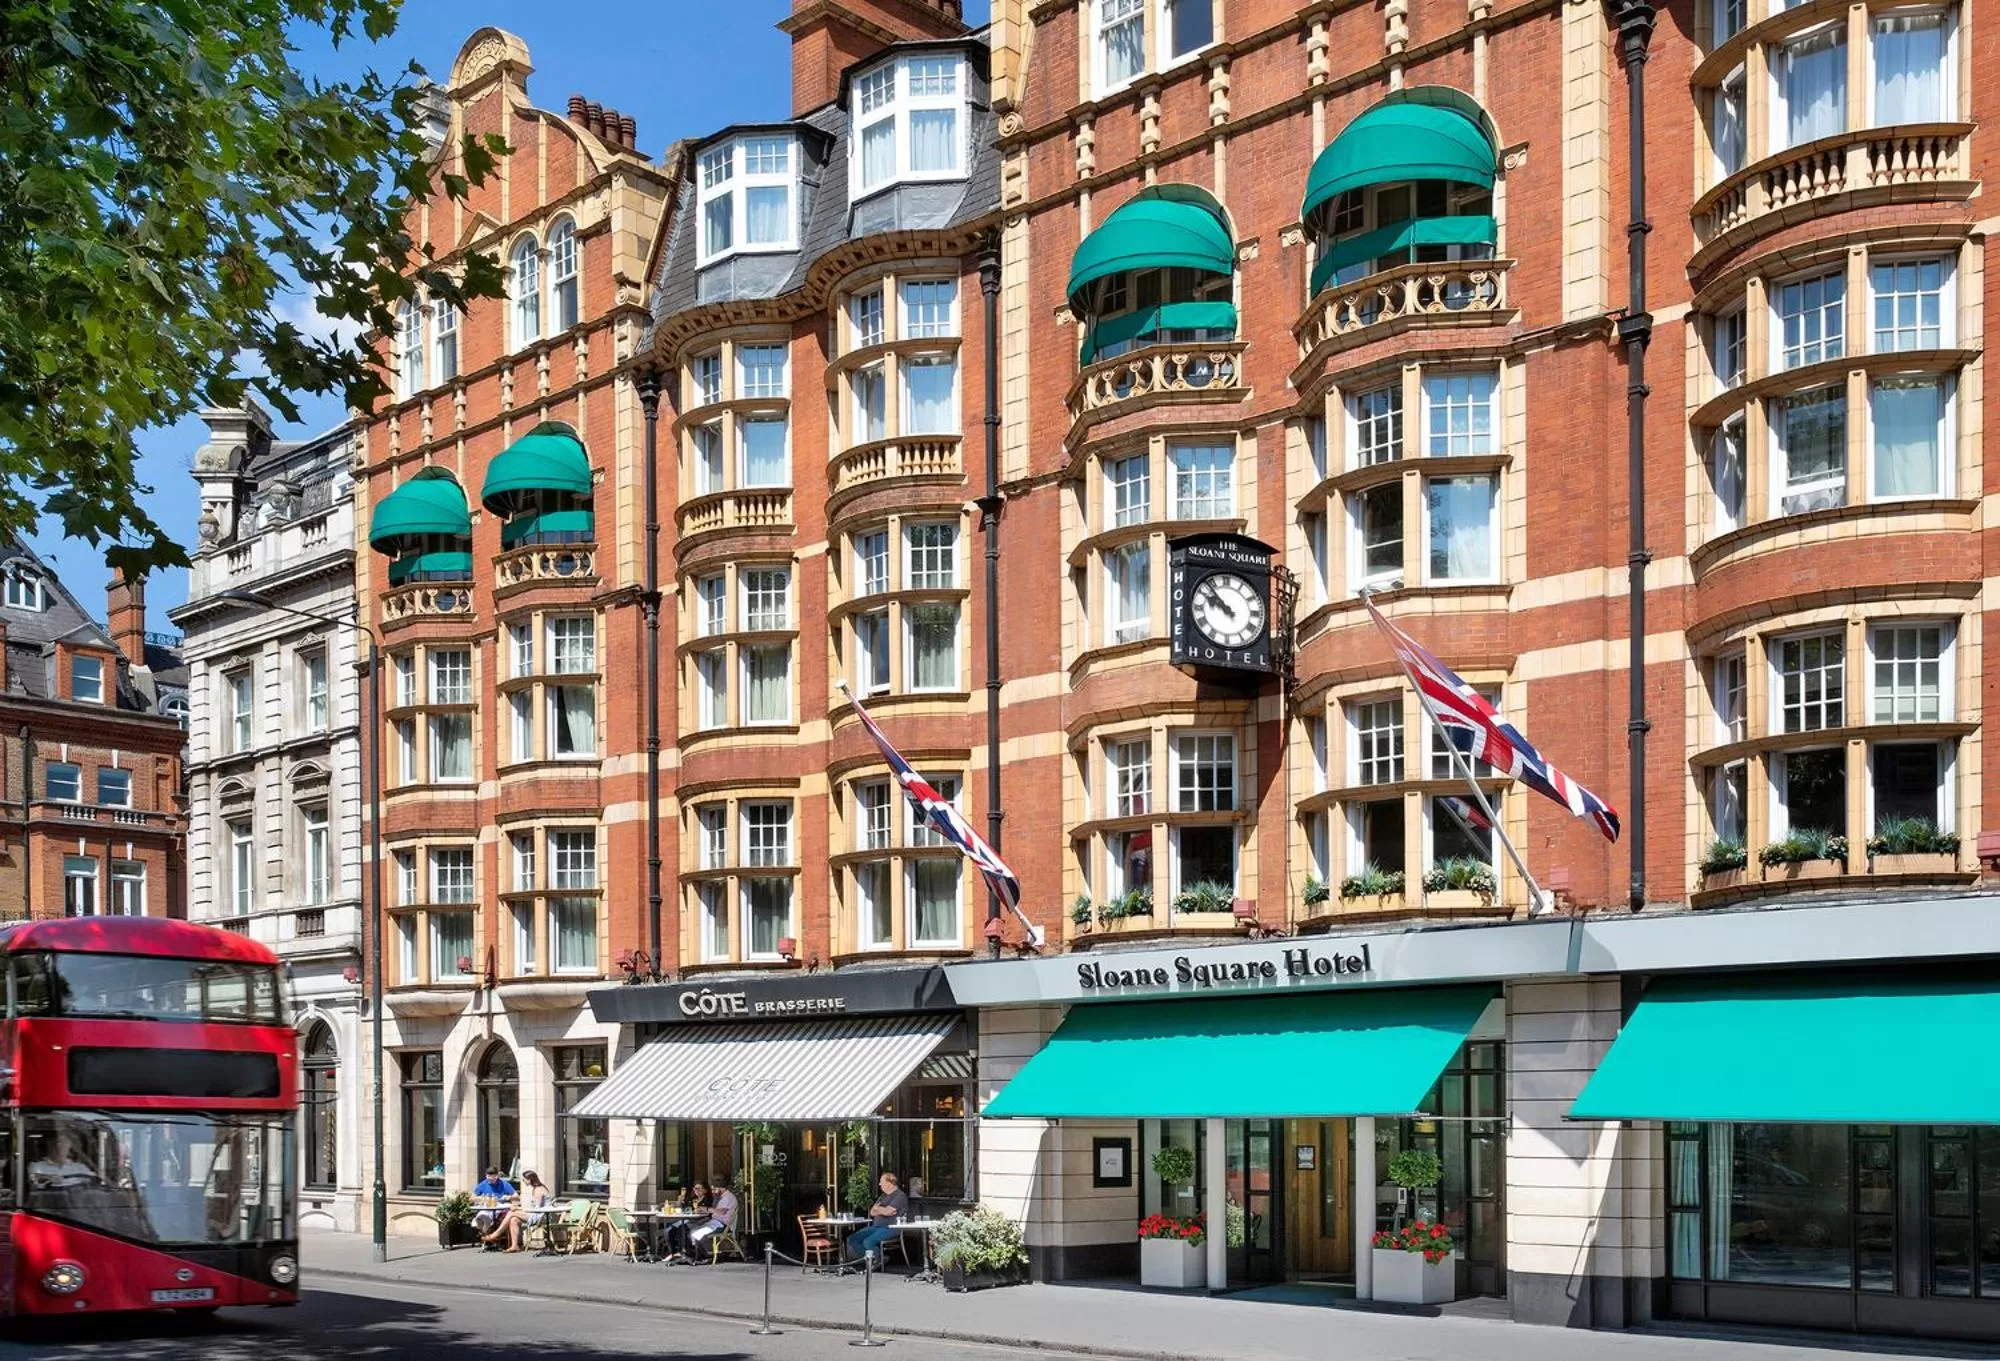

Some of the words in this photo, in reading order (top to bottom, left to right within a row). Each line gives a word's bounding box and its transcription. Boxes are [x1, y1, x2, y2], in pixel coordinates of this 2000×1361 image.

[1174, 572, 1184, 652] HOTEL
[1189, 647, 1266, 665] HOTEL
[1077, 961, 1169, 989] Sloane
[1174, 956, 1277, 987] Square
[1282, 944, 1371, 977] Hotel
[679, 988, 749, 1016] CÔTE
[754, 998, 846, 1013] BRASSERIE
